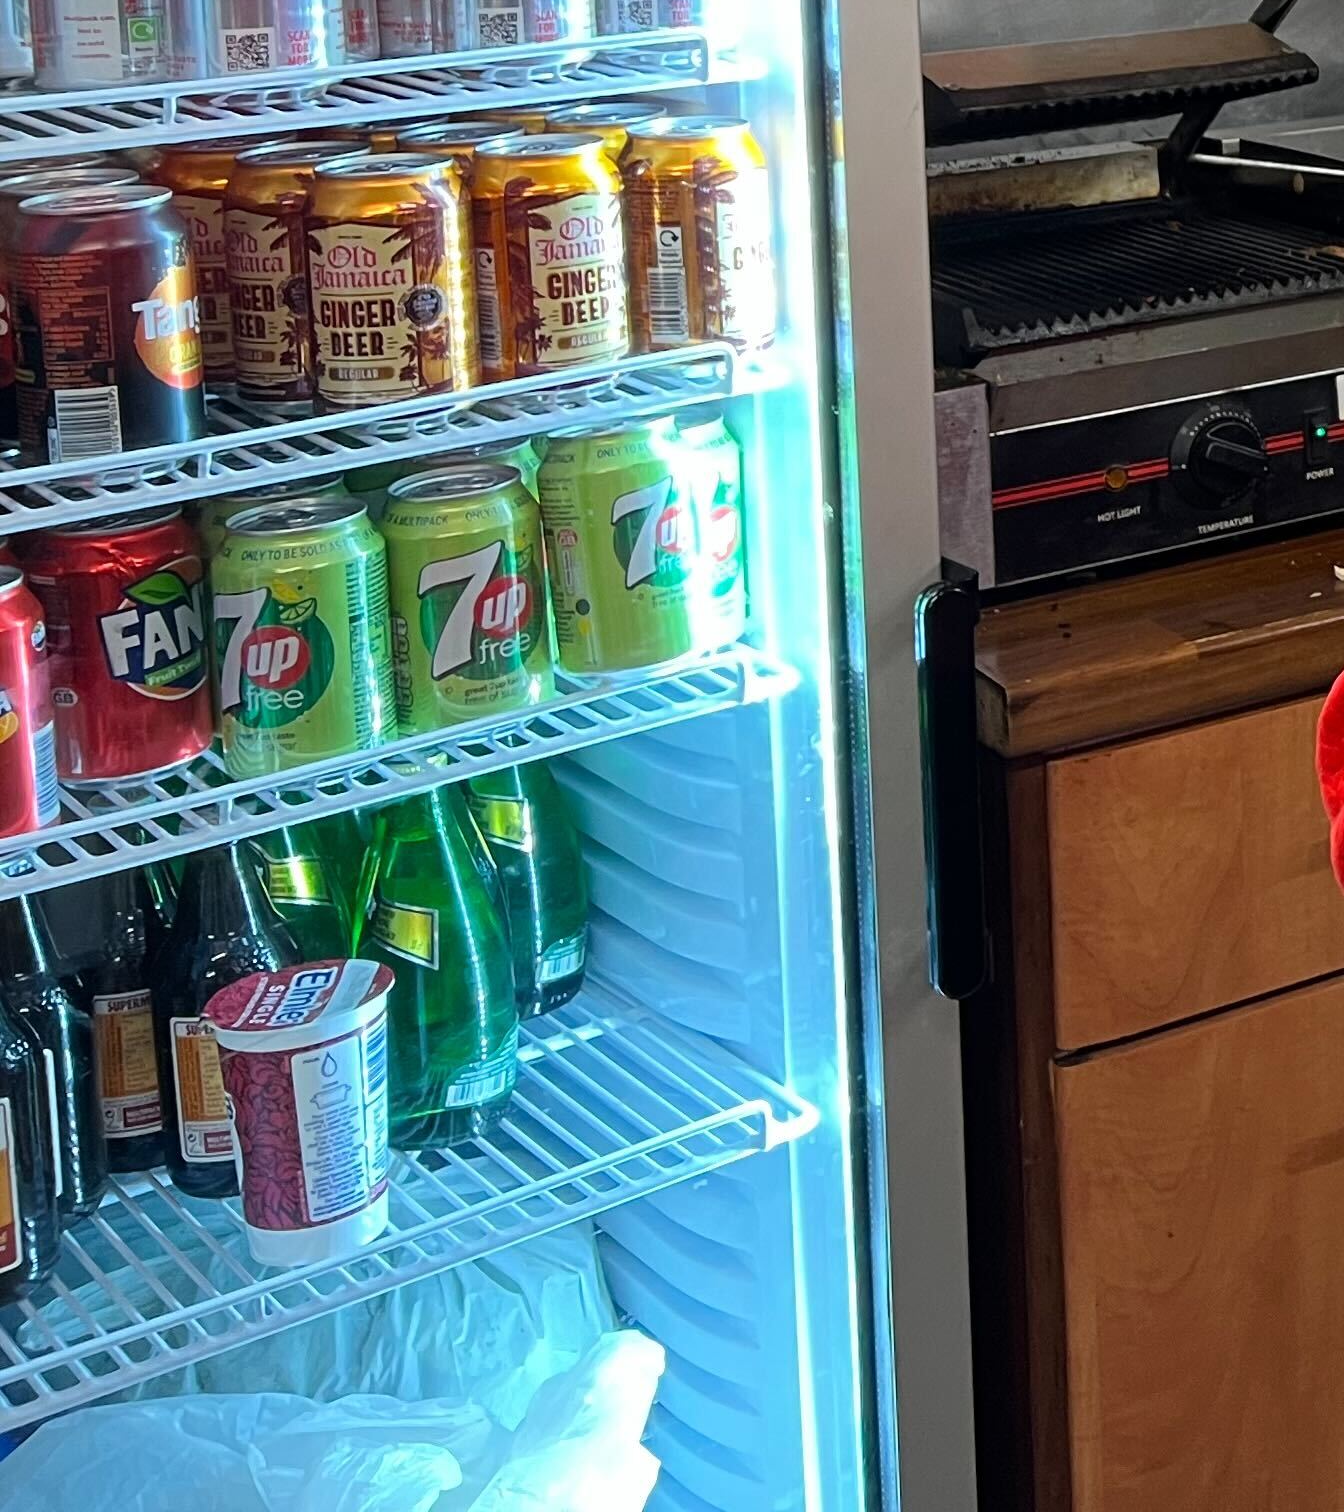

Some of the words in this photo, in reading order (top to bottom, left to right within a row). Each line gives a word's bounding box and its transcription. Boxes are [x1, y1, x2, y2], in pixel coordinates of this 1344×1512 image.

[327, 245, 377, 269] Old
[312, 262, 407, 290] Jamaica
[321, 298, 395, 328] GINGER
[1306, 468, 1334, 480] POWER
[1118, 506, 1141, 520] LIGHT
[1198, 515, 1254, 534] TEMPERATURE
